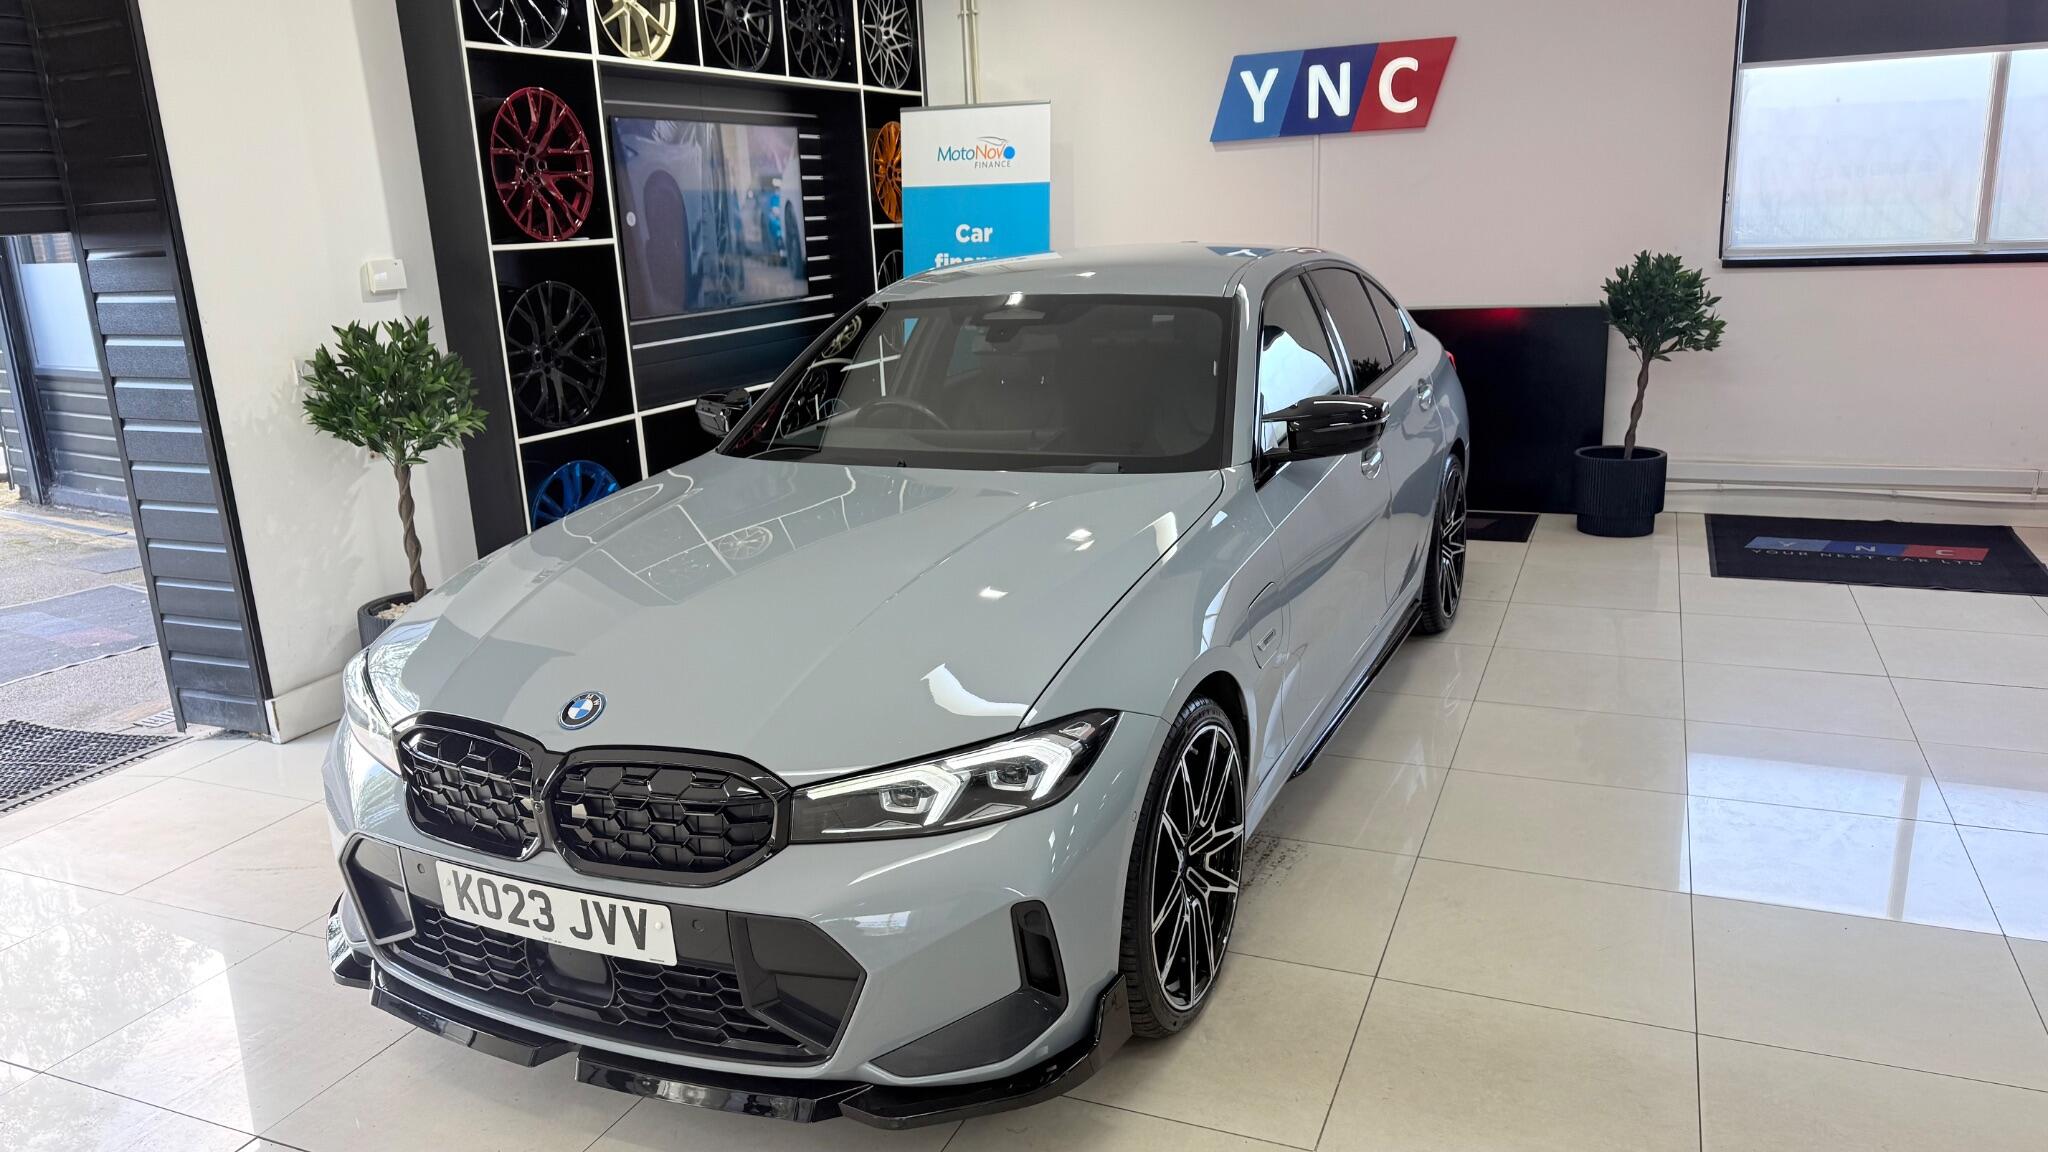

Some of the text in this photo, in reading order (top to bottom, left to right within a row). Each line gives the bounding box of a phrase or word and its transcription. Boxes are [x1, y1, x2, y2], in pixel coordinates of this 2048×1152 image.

[1239, 56, 1419, 123] YNC
[974, 160, 1011, 169] FINANCE
[955, 223, 994, 243] Car
[1820, 552, 1874, 560] NEXT
[451, 869, 648, 951] KO23 JVV
